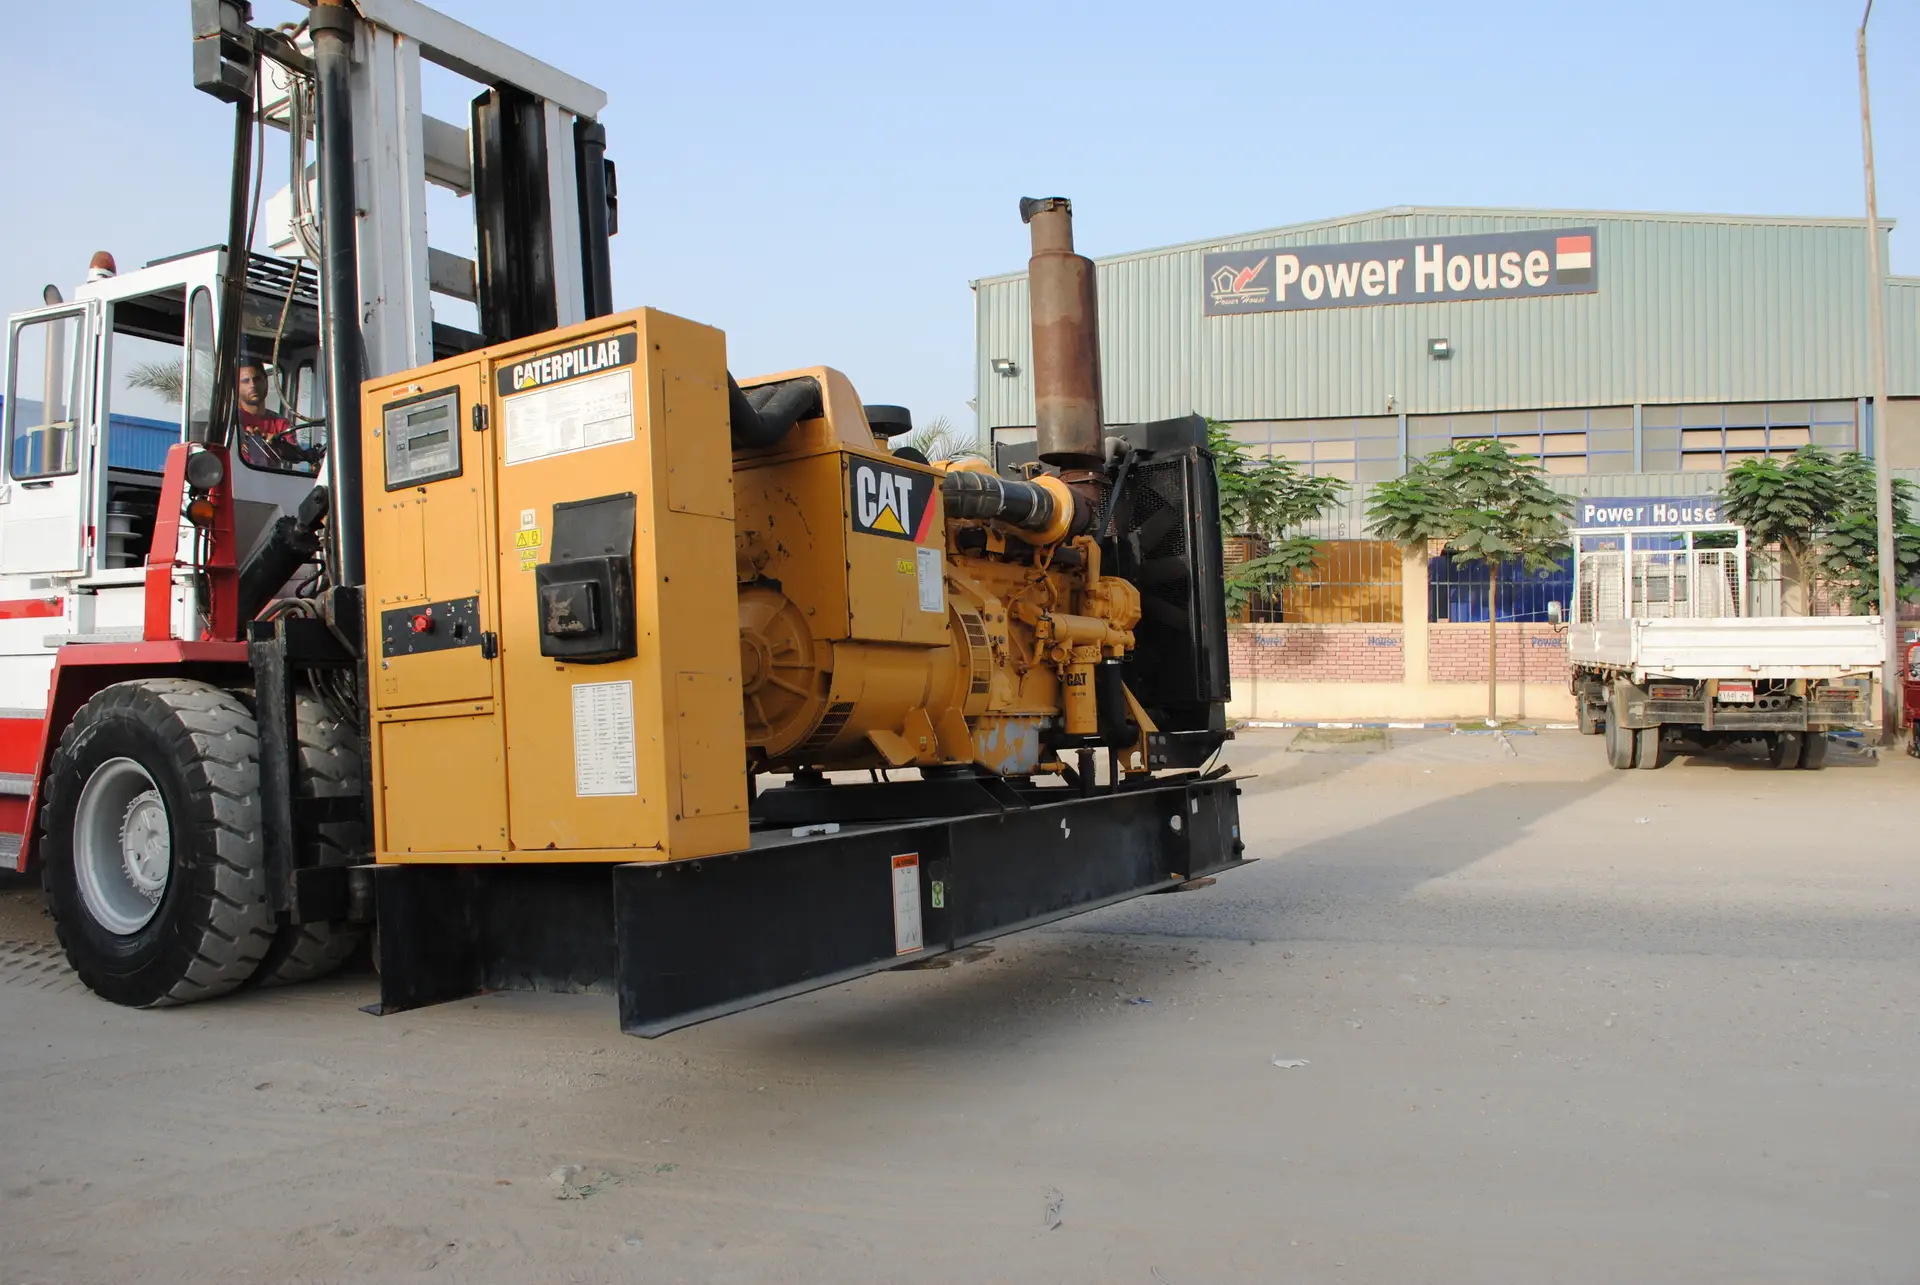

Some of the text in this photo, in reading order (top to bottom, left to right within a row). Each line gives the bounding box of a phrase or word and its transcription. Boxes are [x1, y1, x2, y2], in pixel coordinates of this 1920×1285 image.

[1276, 243, 1550, 302] Power House
[1214, 295, 1266, 306] Power House
[513, 339, 621, 390] CATERPILLAR
[856, 465, 913, 535] CAT
[1584, 503, 1717, 523] Power House
[1067, 672, 1087, 686] CAT
